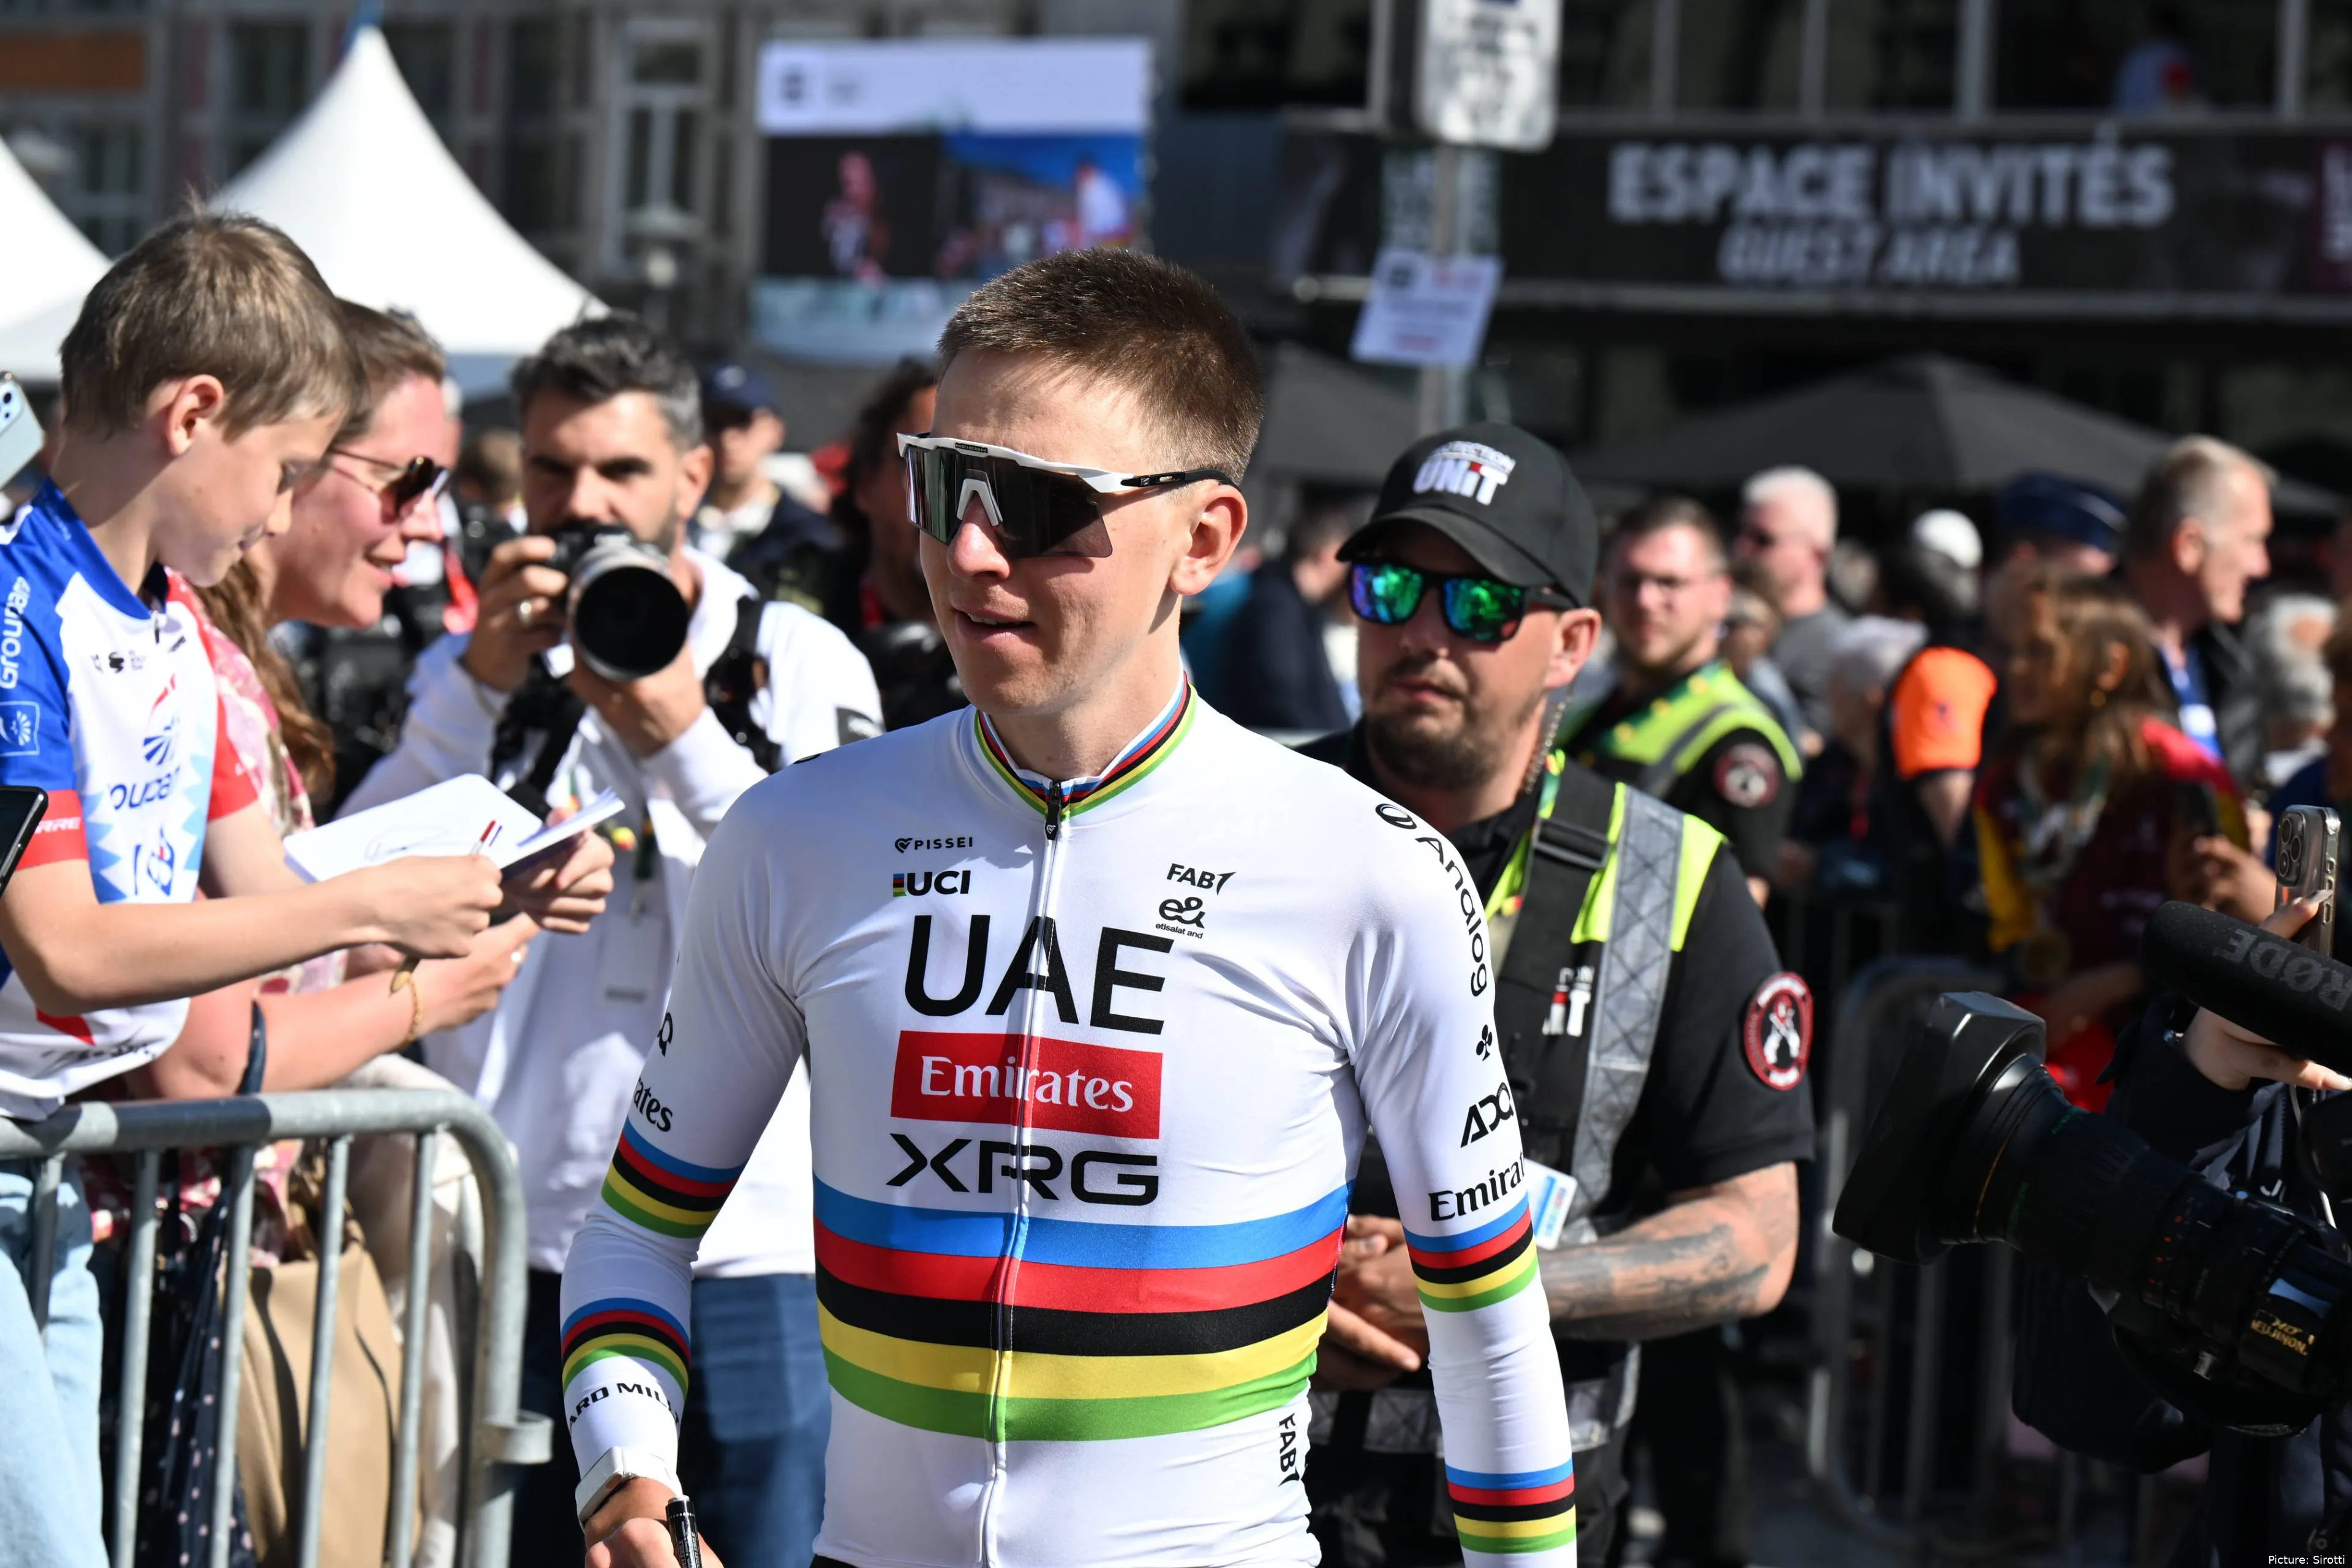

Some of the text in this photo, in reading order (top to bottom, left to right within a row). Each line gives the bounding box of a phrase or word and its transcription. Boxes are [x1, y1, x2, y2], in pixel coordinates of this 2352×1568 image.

[1608, 143, 1874, 221] ESPACE
[1885, 124, 2174, 227] INVITÉS
[1719, 224, 2019, 284] GUEST AREA
[914, 837, 973, 850] PISSEI
[907, 870, 971, 896] UCI
[1155, 923, 1204, 939] etisalat and
[1414, 837, 1487, 997] Analog
[905, 914, 1174, 1035] UAE
[921, 1055, 1134, 1113] Emirates
[886, 1133, 1159, 1206] XRG
